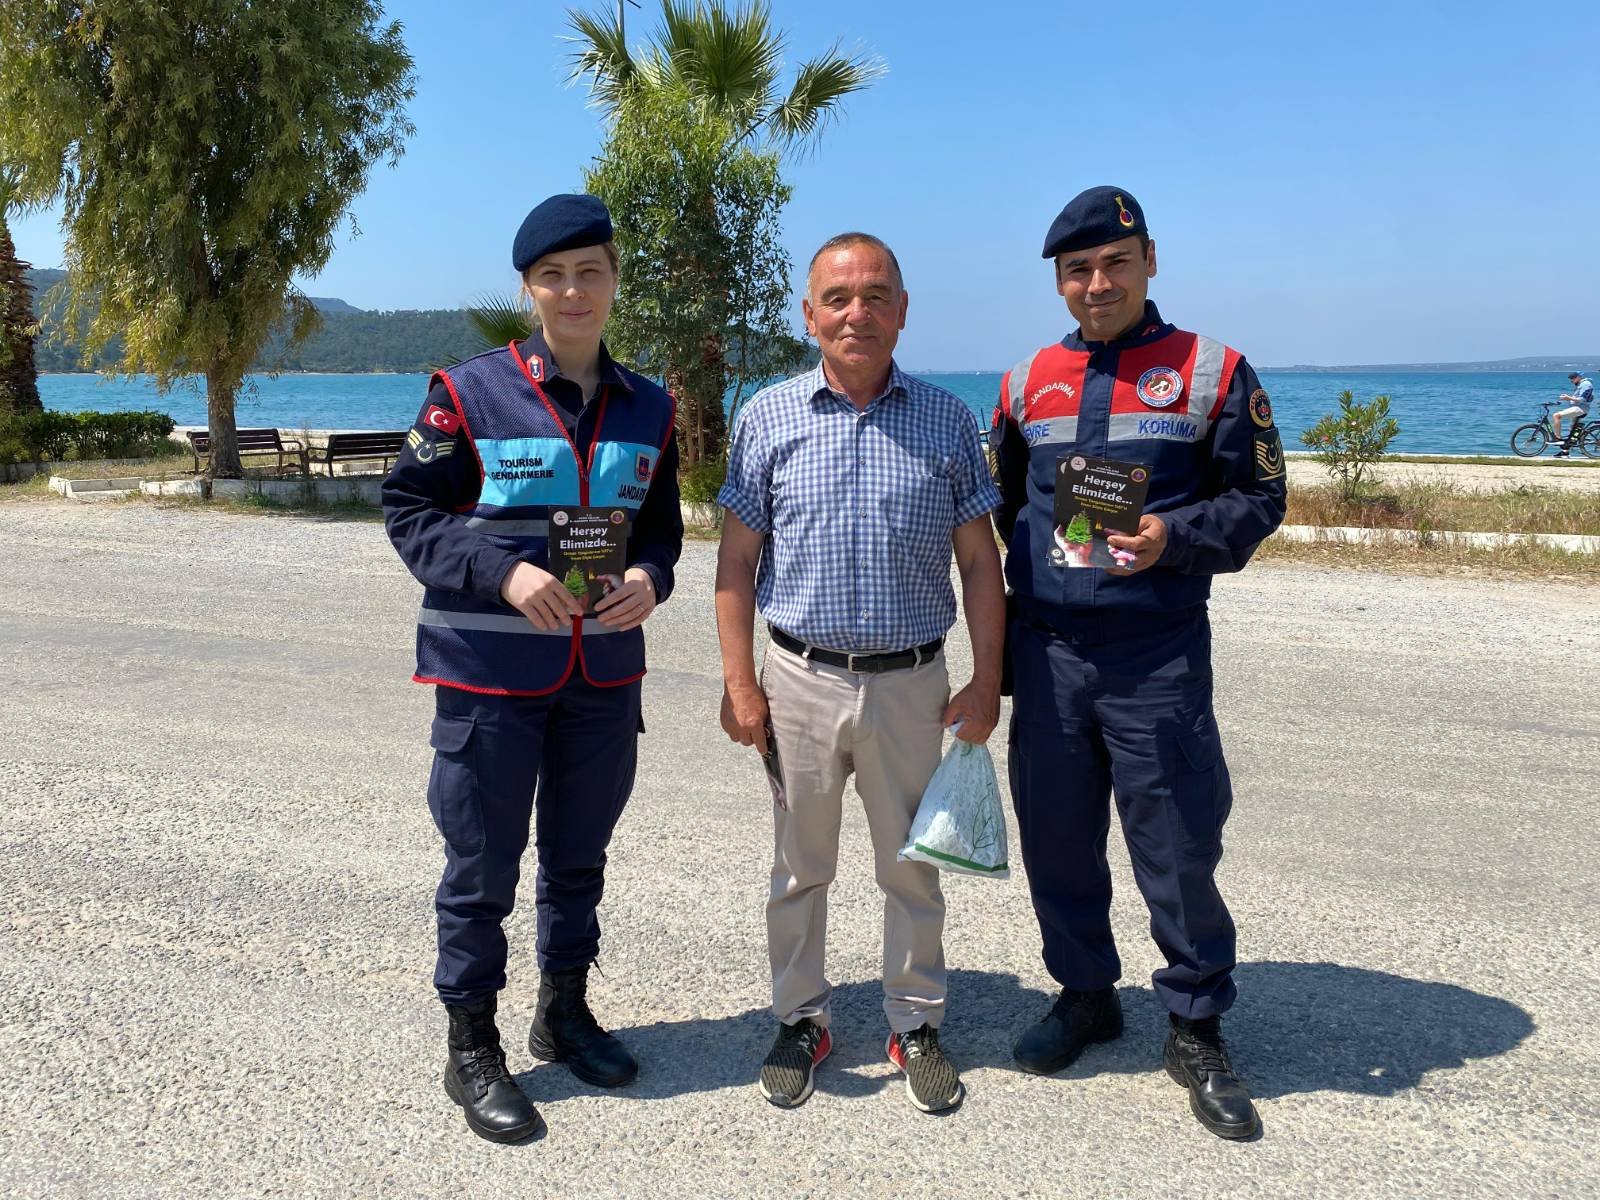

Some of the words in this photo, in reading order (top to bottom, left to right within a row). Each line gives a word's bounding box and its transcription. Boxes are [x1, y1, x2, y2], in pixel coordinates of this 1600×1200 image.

[1030, 382, 1075, 405] JANDARMA
[1024, 423, 1050, 440] EVRE
[1138, 420, 1198, 438] KORUMA
[498, 458, 542, 468] TOURISM
[491, 469, 555, 480] GENDARMERIE
[1084, 474, 1126, 492] Herşey
[617, 484, 648, 502] JANDAR
[569, 527, 608, 537] Herşey
